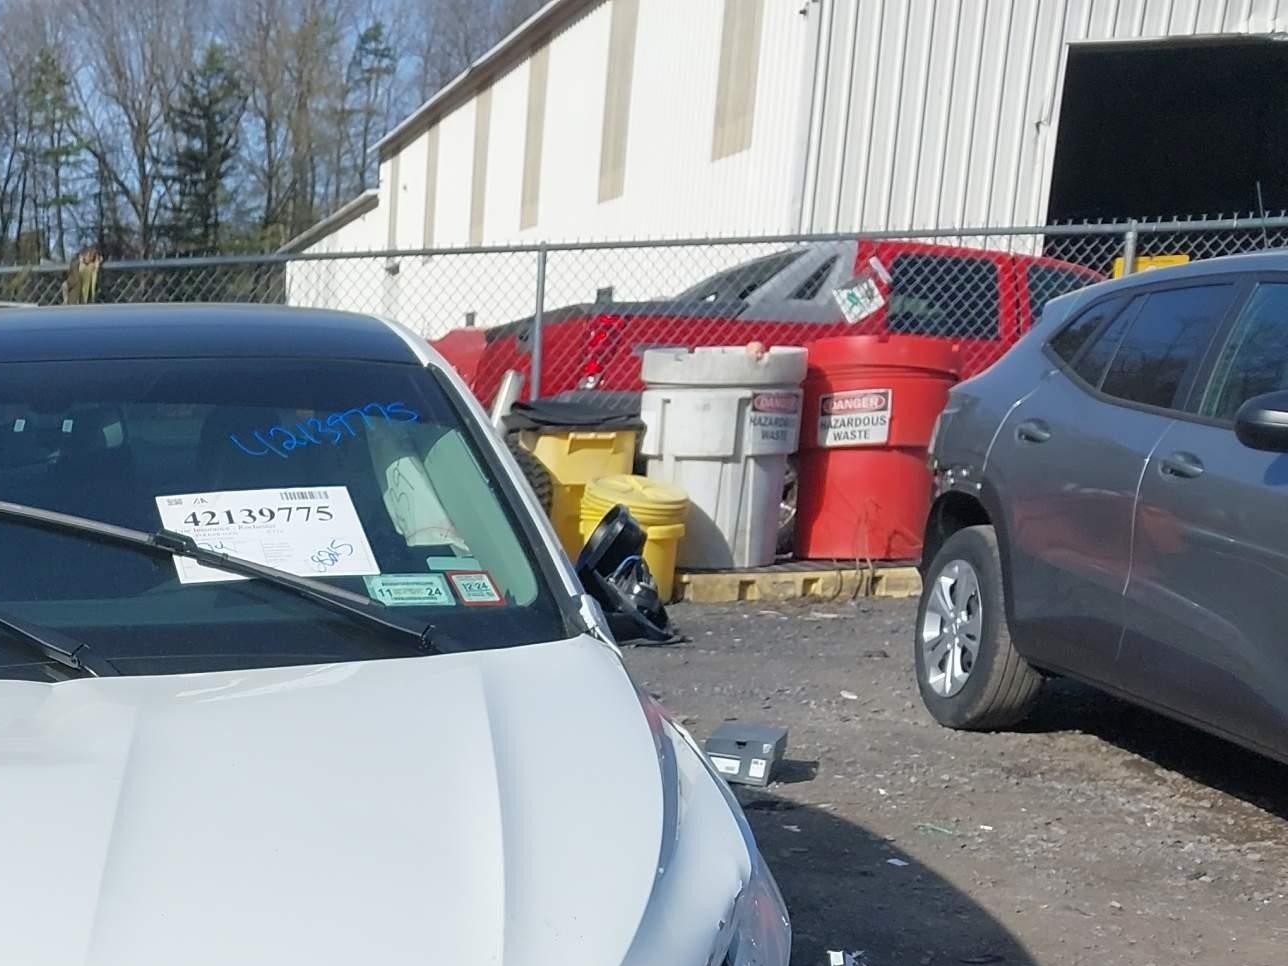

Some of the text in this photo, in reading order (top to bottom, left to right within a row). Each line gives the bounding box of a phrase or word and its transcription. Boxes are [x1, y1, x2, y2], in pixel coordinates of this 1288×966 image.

[820, 415, 887, 430] HAZARDOUS
[832, 429, 871, 441] WASTE
[183, 505, 333, 527] 42139775
[378, 587, 442, 597] 11 24
